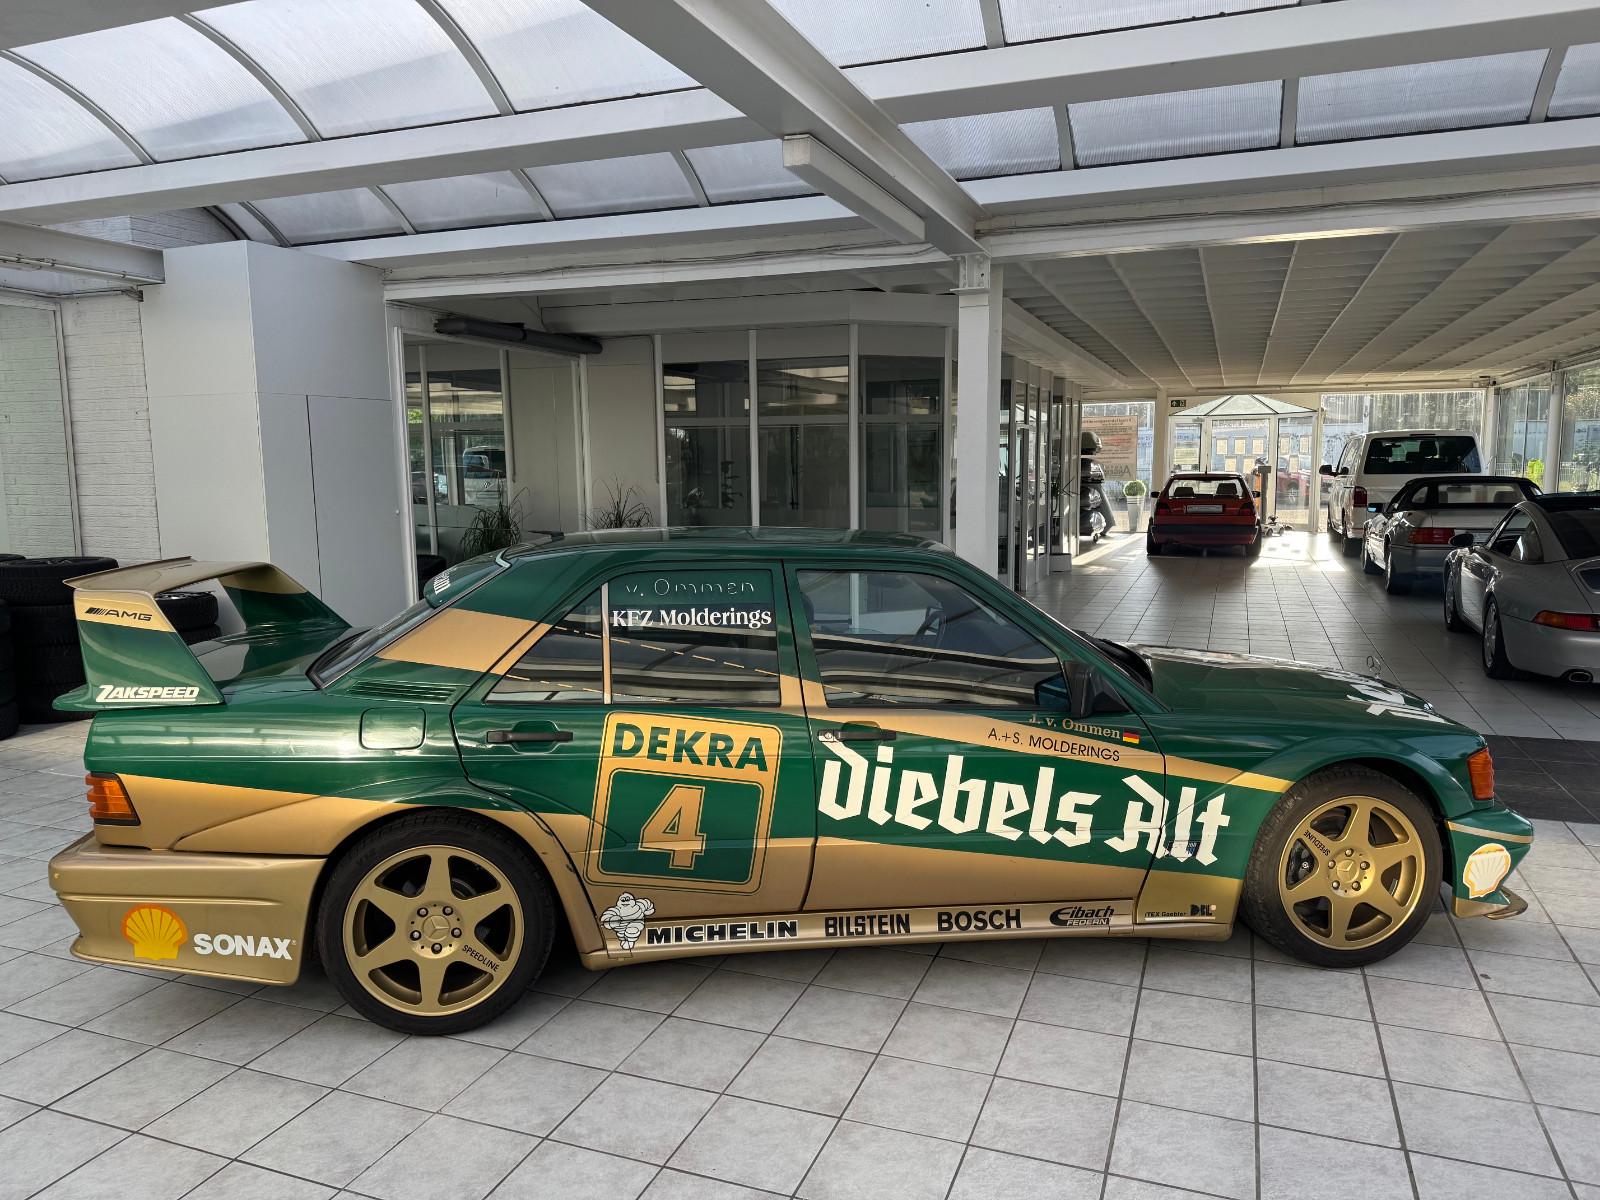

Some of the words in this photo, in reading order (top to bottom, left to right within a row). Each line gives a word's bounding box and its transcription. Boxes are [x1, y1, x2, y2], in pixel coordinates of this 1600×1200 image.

[654, 578, 755, 596] Ommen
[105, 608, 153, 622] AMG
[612, 609, 653, 627] KFZ
[659, 607, 772, 629] Molderings
[95, 684, 200, 703] ZAKSPEED
[1062, 718, 1121, 739] Ommen
[612, 722, 768, 772] DEKRA
[1028, 735, 1120, 762] MOLDERINGS
[817, 731, 1101, 848] Diebels
[1103, 774, 1230, 866] Alt
[638, 783, 707, 870] 4
[1303, 829, 1331, 856] SPEEDLINE
[824, 913, 911, 937] BILSTEIN
[937, 908, 1022, 932] BOSCH
[1049, 905, 1115, 926] Eibach
[646, 919, 798, 945] MICHELIN
[193, 933, 293, 960] SONAX
[461, 944, 500, 973] SPEEDLINE
